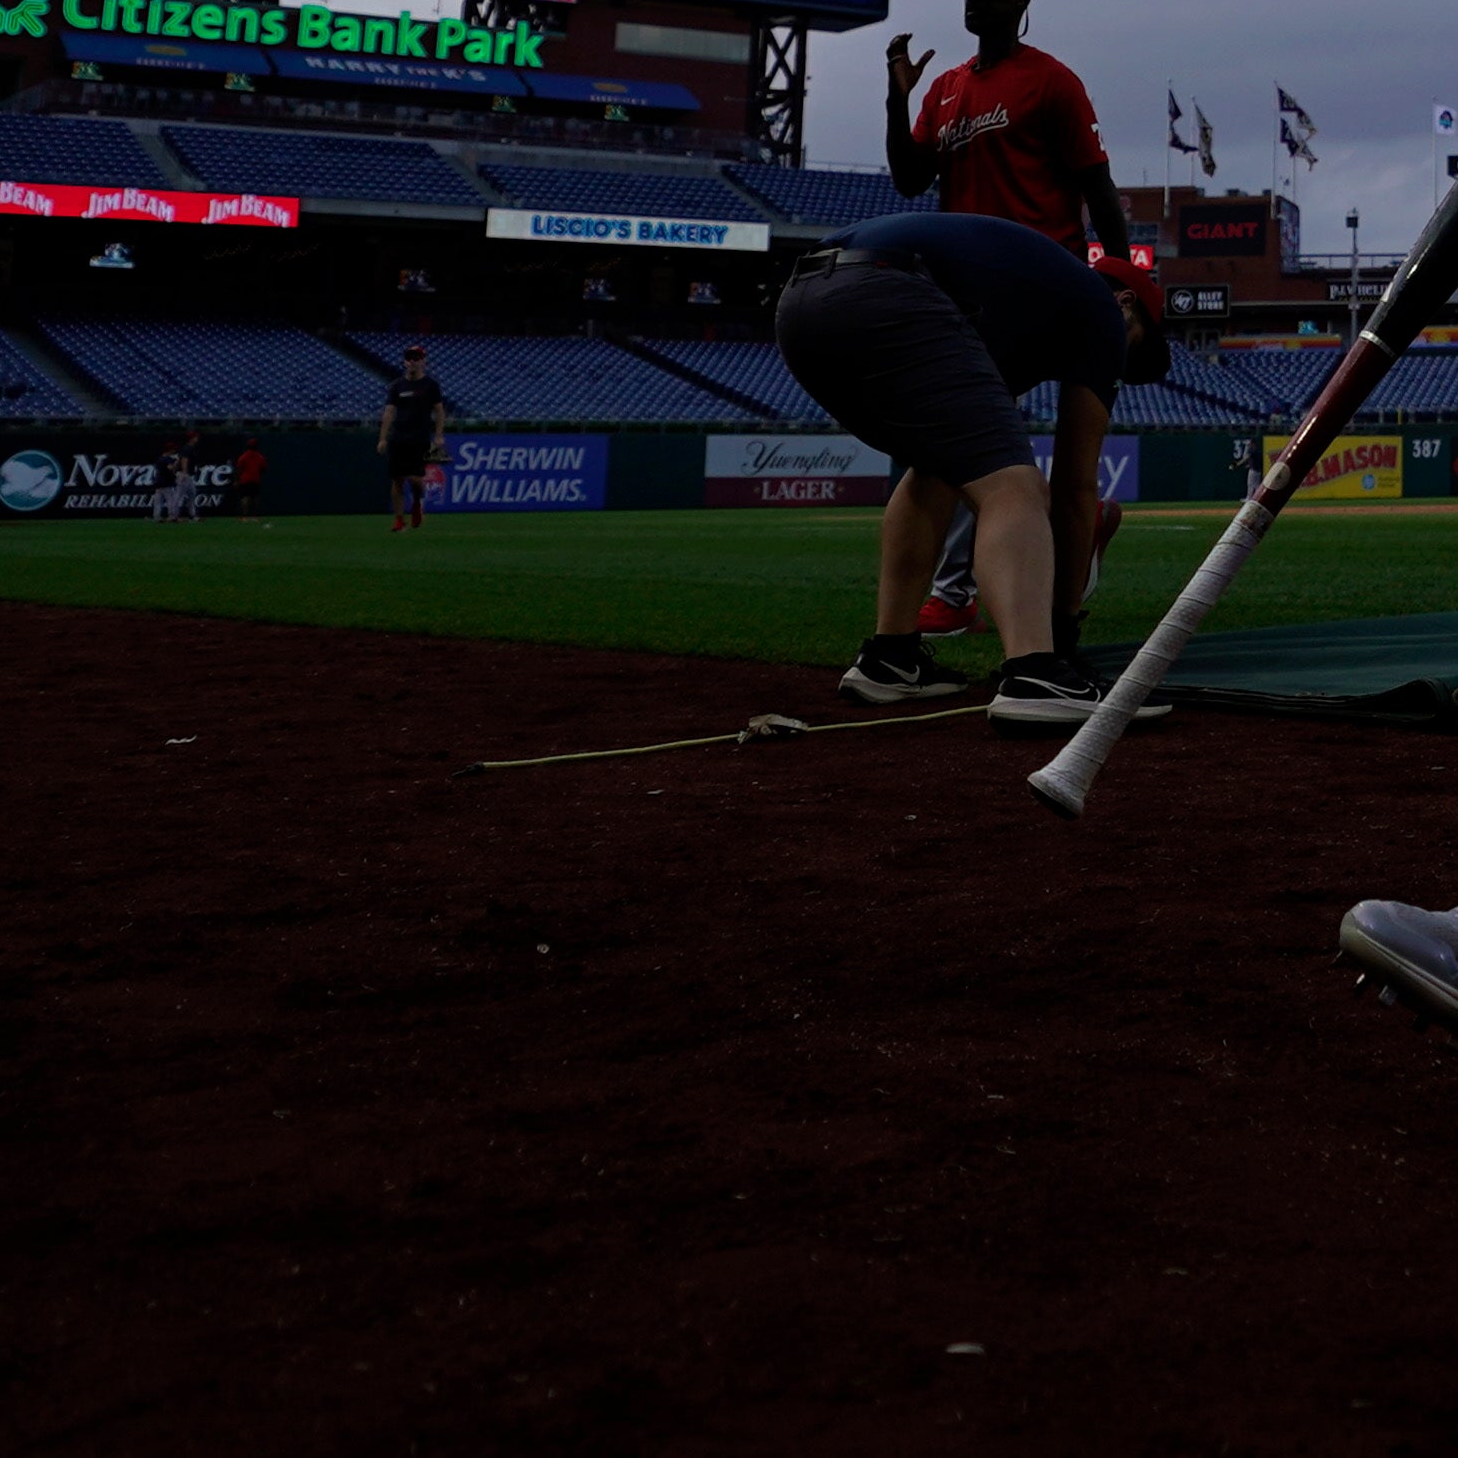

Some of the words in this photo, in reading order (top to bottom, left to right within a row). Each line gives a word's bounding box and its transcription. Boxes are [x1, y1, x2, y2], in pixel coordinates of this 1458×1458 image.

[297, 3, 428, 58] Bank
[435, 18, 543, 68] Park
[81, 191, 124, 219] JIM
[123, 187, 176, 223] BEAM
[202, 197, 241, 224] JIM
[241, 193, 291, 228] BEAM
[531, 214, 632, 239] LISCIO'S
[641, 222, 730, 245] BAKERY
[1186, 221, 1260, 239] GIANT
[453, 441, 585, 472] SHERWIN
[742, 441, 859, 476] Yuengling
[1412, 439, 1441, 459] 387
[63, 453, 232, 488] Novare
[450, 474, 582, 503] WILLIAMS
[761, 480, 836, 501] LAGER
